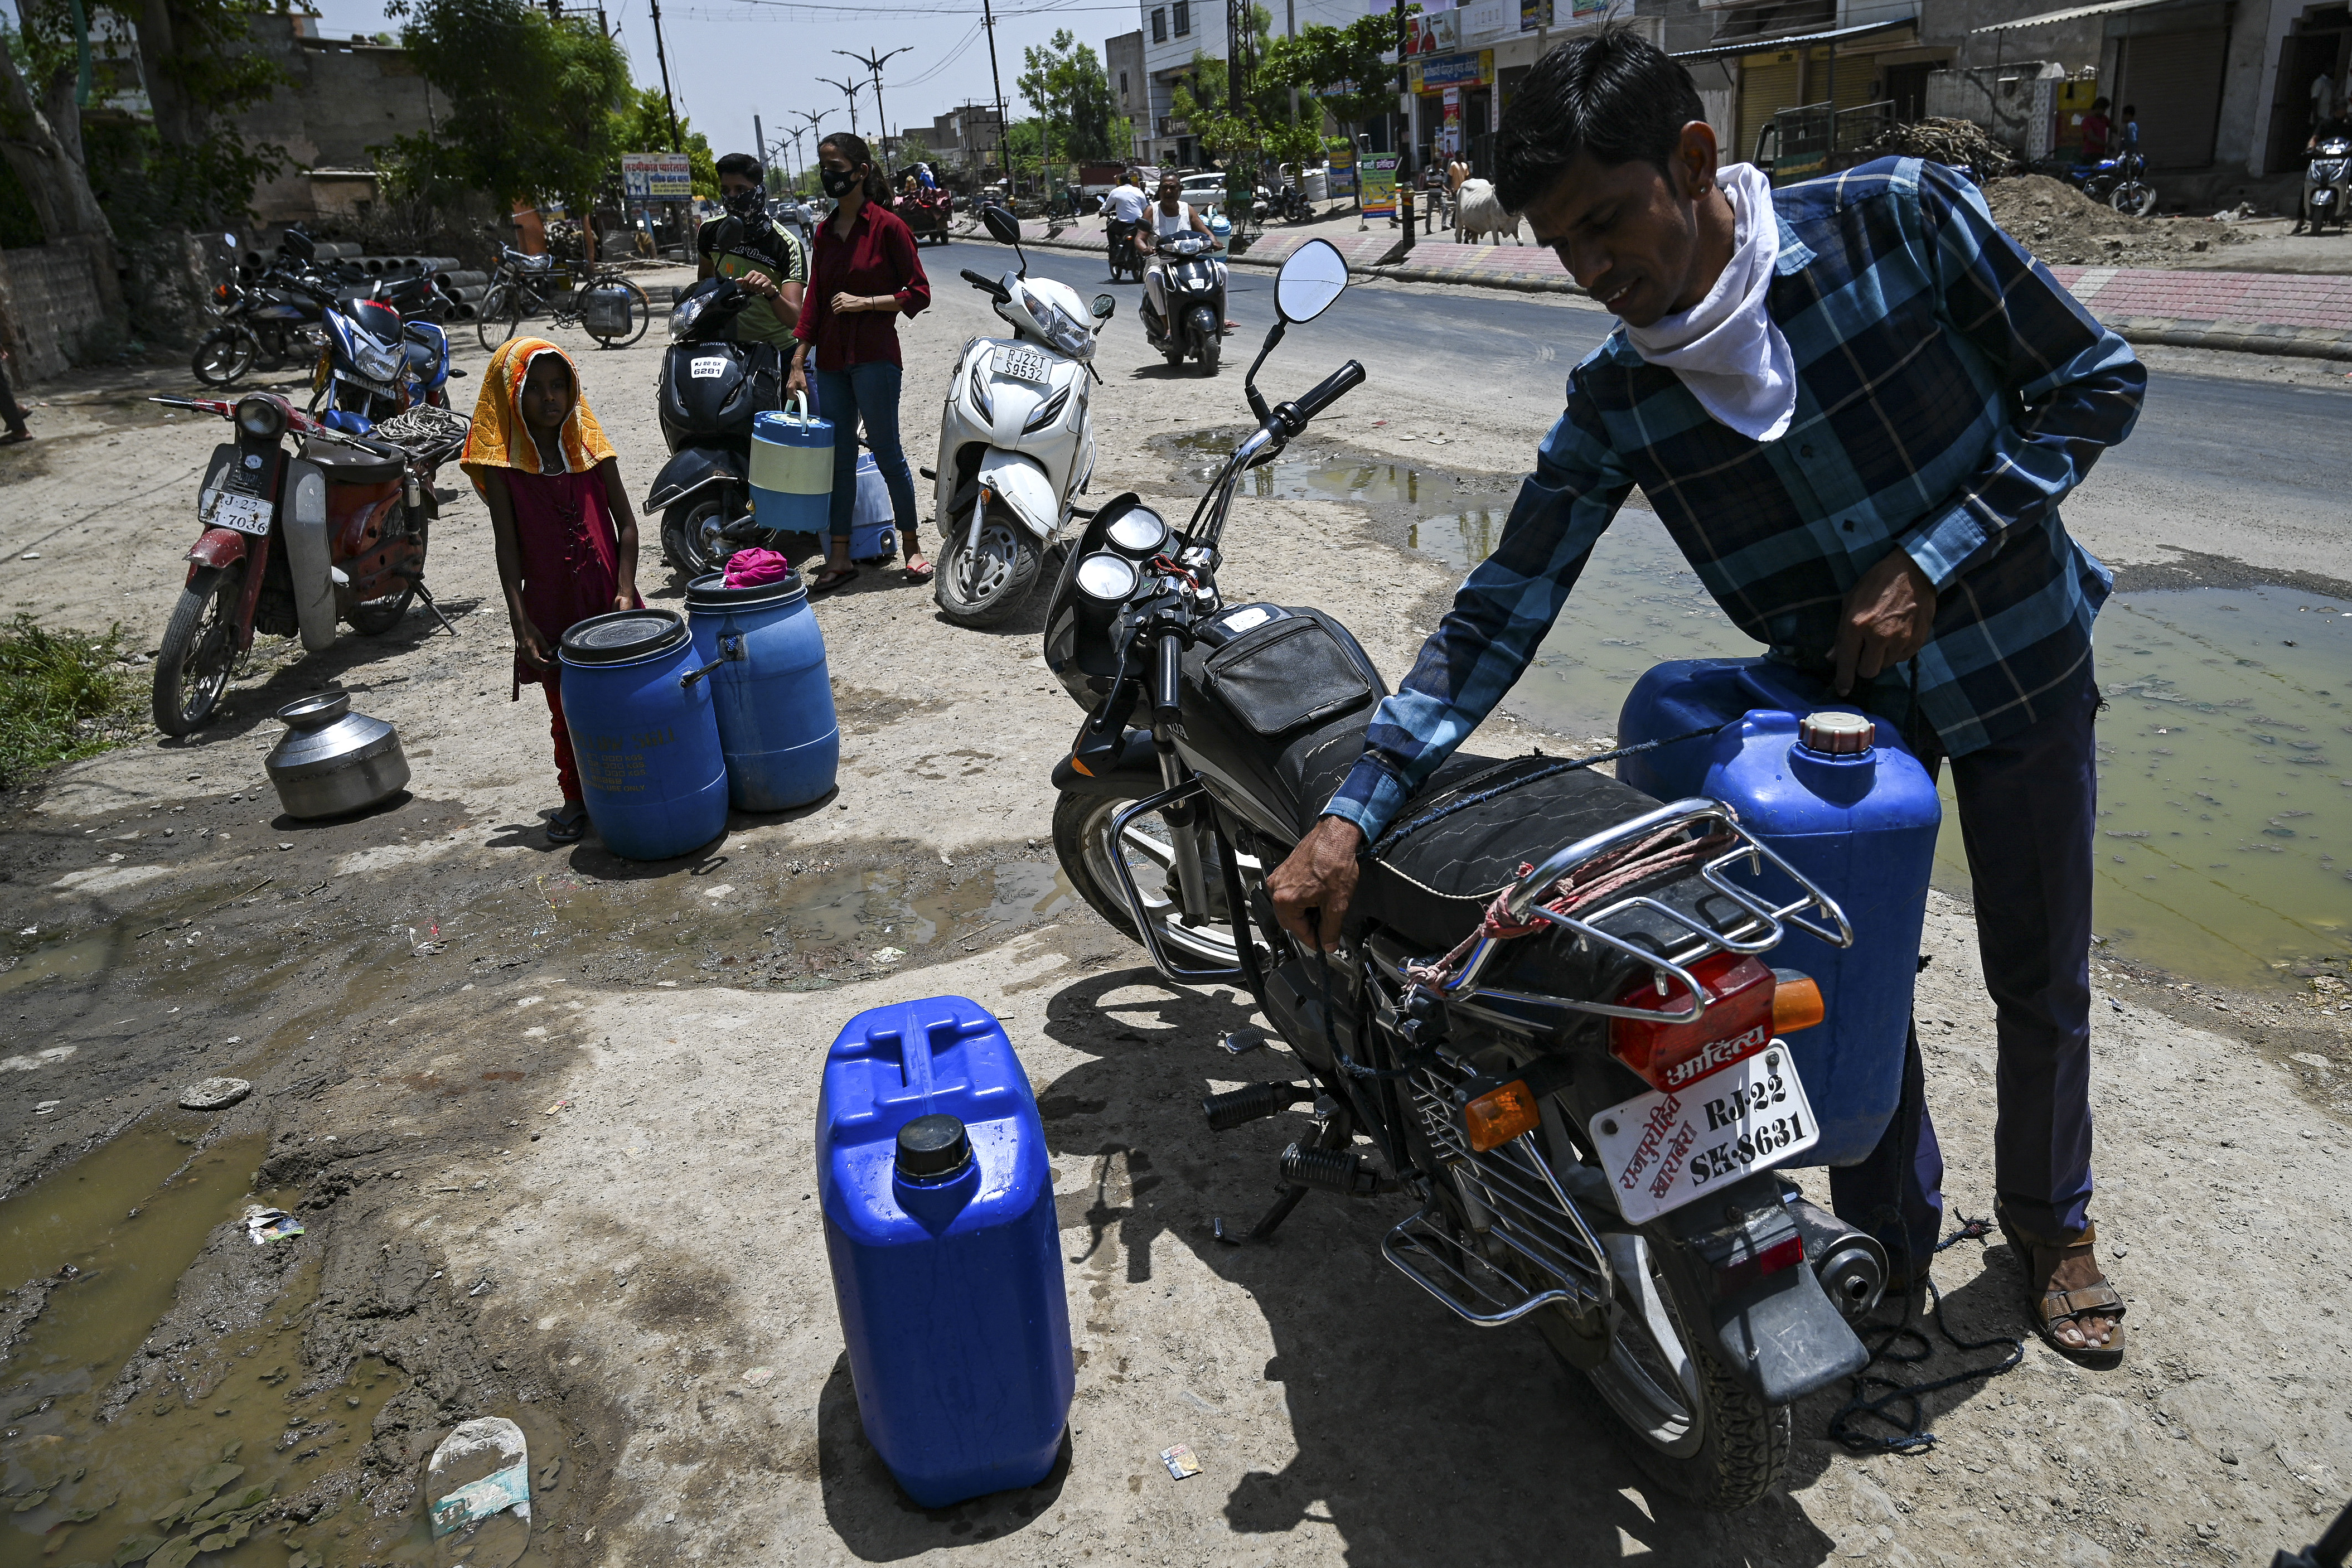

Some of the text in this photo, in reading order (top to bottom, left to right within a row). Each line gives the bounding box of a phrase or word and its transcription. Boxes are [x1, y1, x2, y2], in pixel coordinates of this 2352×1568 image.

[1008, 349, 1046, 369] RJ22T
[1004, 362, 1043, 381] S9532
[1666, 1025, 1767, 1086] आदित्य
